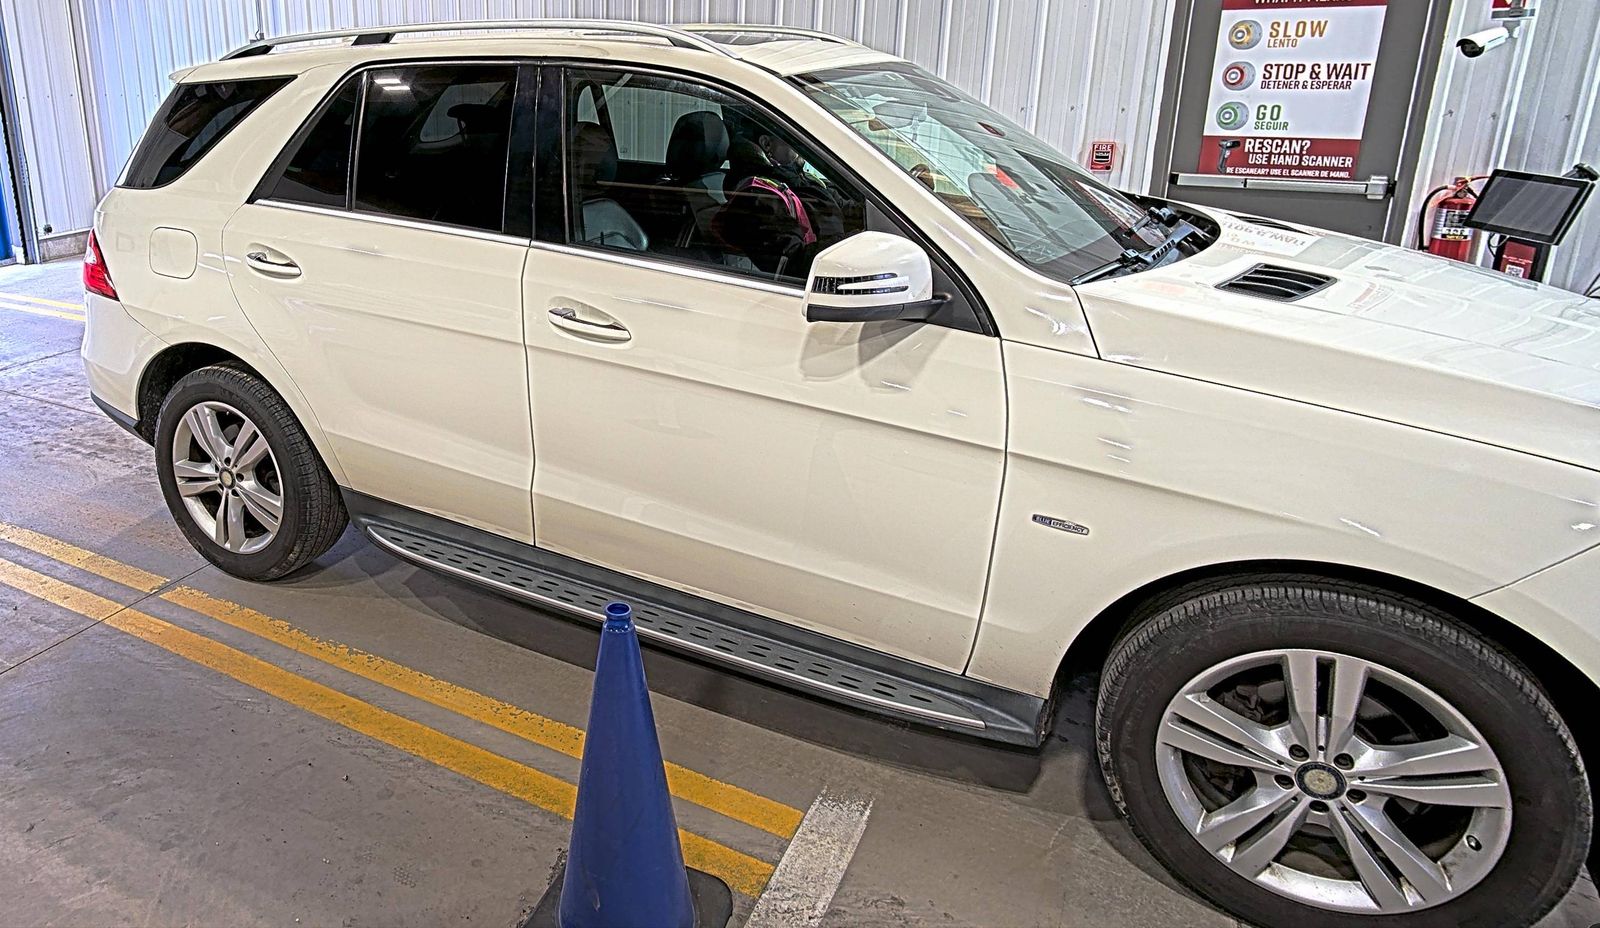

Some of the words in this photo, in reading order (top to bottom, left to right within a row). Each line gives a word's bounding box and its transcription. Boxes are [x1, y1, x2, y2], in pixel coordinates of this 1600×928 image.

[1269, 20, 1329, 38] SLOW
[1267, 38, 1298, 48] LENTO
[1262, 63, 1306, 80] STOP
[1309, 63, 1322, 80] &
[1326, 63, 1371, 81] WAIT
[1260, 80, 1300, 90] DETENER
[1301, 80, 1309, 90] &
[1310, 80, 1352, 90] ESPERAR
[1255, 104, 1282, 121] GO
[1253, 121, 1289, 131] SEGUIR
[1244, 138, 1311, 155] RESCAN?
[1248, 153, 1269, 165] USE
[1270, 154, 1300, 166] HAND
[1301, 155, 1353, 168] SCANNER
[1270, 168, 1281, 176] USE
[1290, 169, 1319, 178] SCANNER
[1320, 170, 1329, 178] DE
